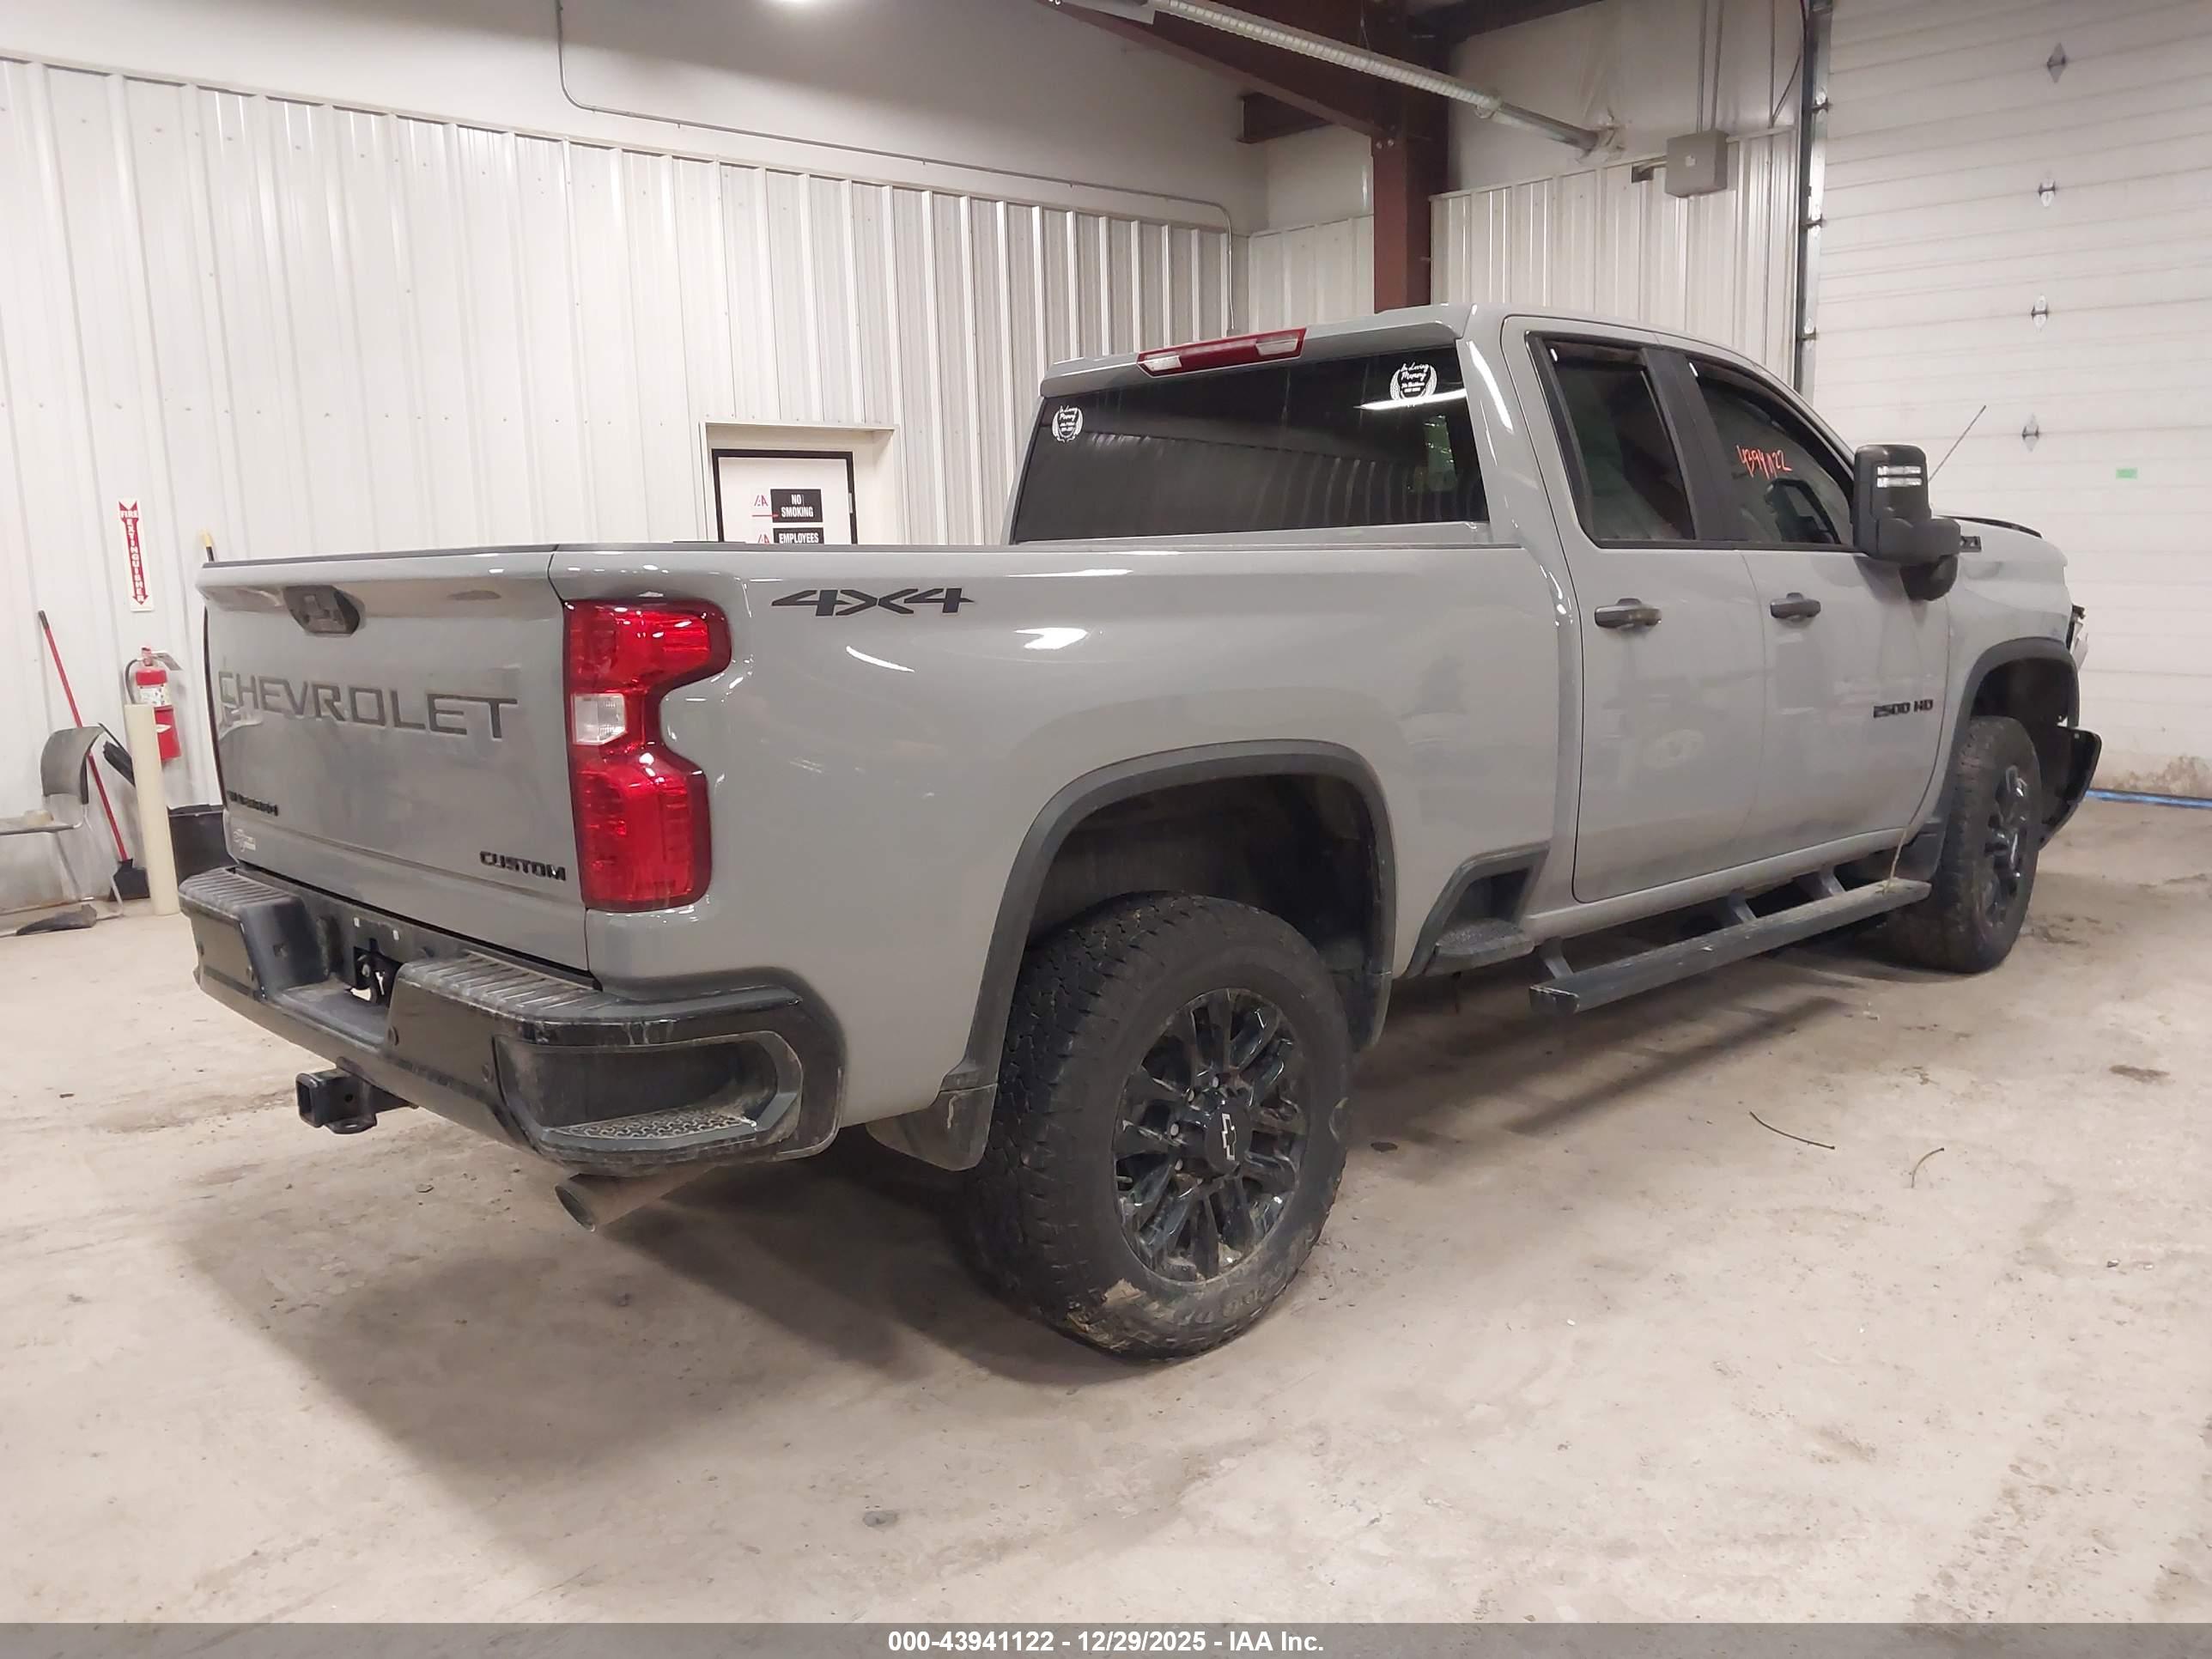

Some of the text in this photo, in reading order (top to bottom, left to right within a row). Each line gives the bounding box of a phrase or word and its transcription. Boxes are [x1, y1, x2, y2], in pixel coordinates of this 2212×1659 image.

[791, 494, 802, 505] NO
[120, 509, 137, 519] FIRE
[781, 506, 814, 518] SMOKING
[778, 532, 819, 544] EMPLOYEES
[126, 518, 145, 603] EXTINGUISHER
[218, 670, 518, 740] CHEVROLET
[1873, 698, 1934, 719] 2500 HD
[479, 850, 567, 881] CUSTOM
